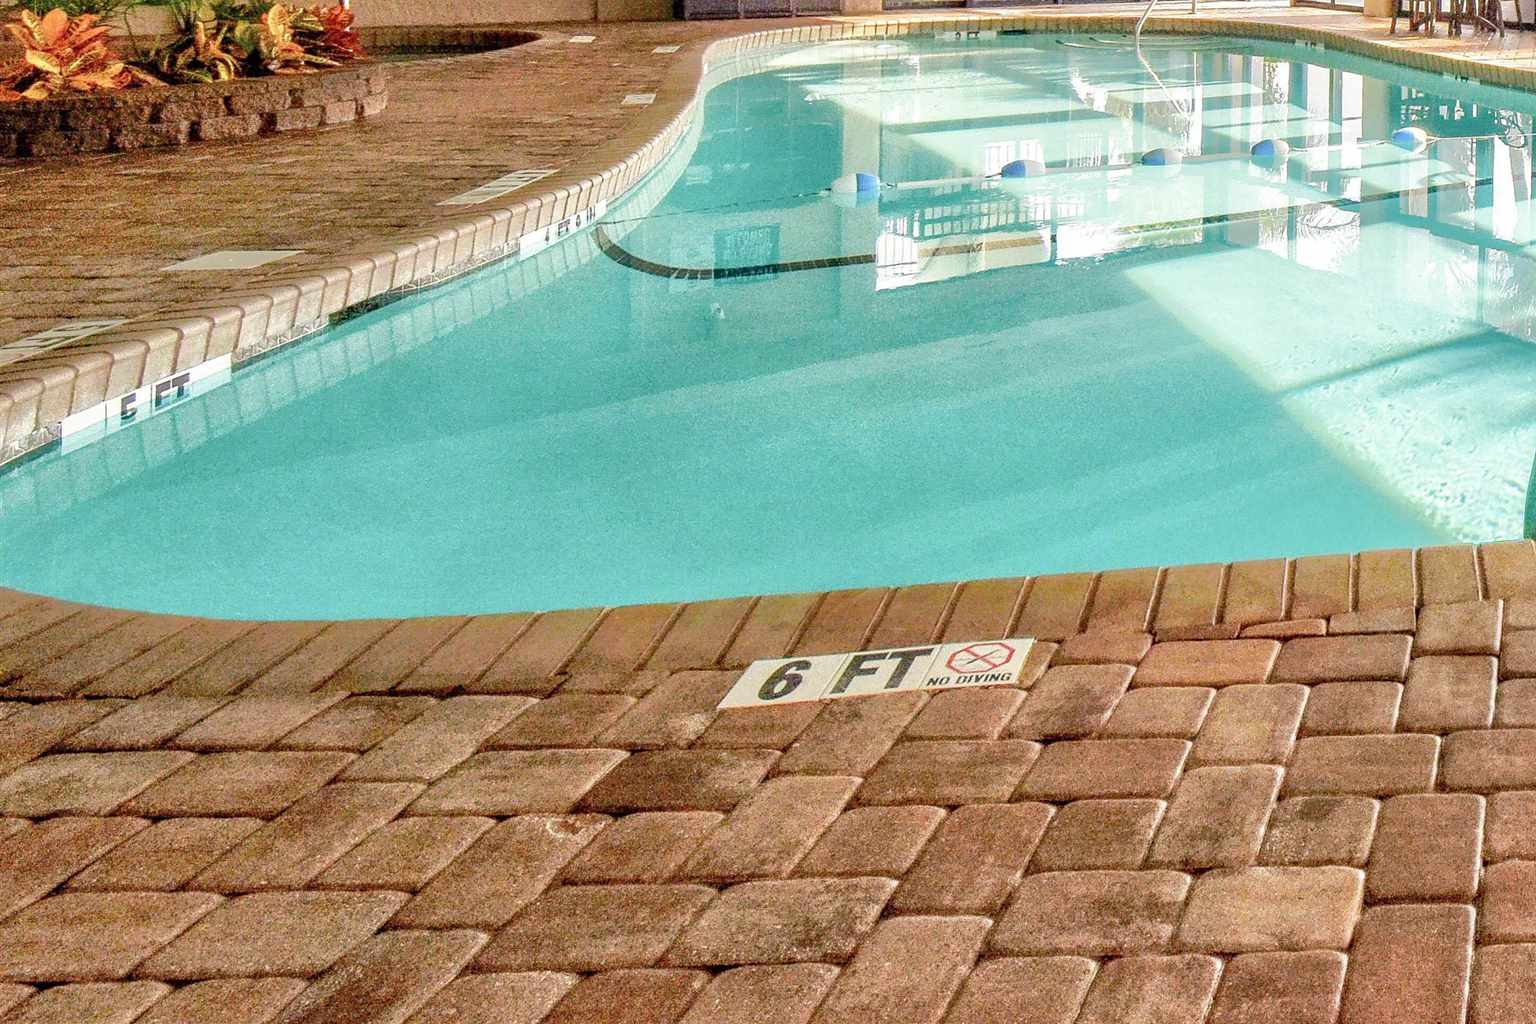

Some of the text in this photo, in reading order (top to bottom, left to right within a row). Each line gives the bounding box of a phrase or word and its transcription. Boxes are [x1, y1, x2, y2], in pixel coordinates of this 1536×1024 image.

[155, 372, 191, 408] FT
[757, 649, 935, 701] 6 FT
[925, 672, 1013, 687] NO DIVING
